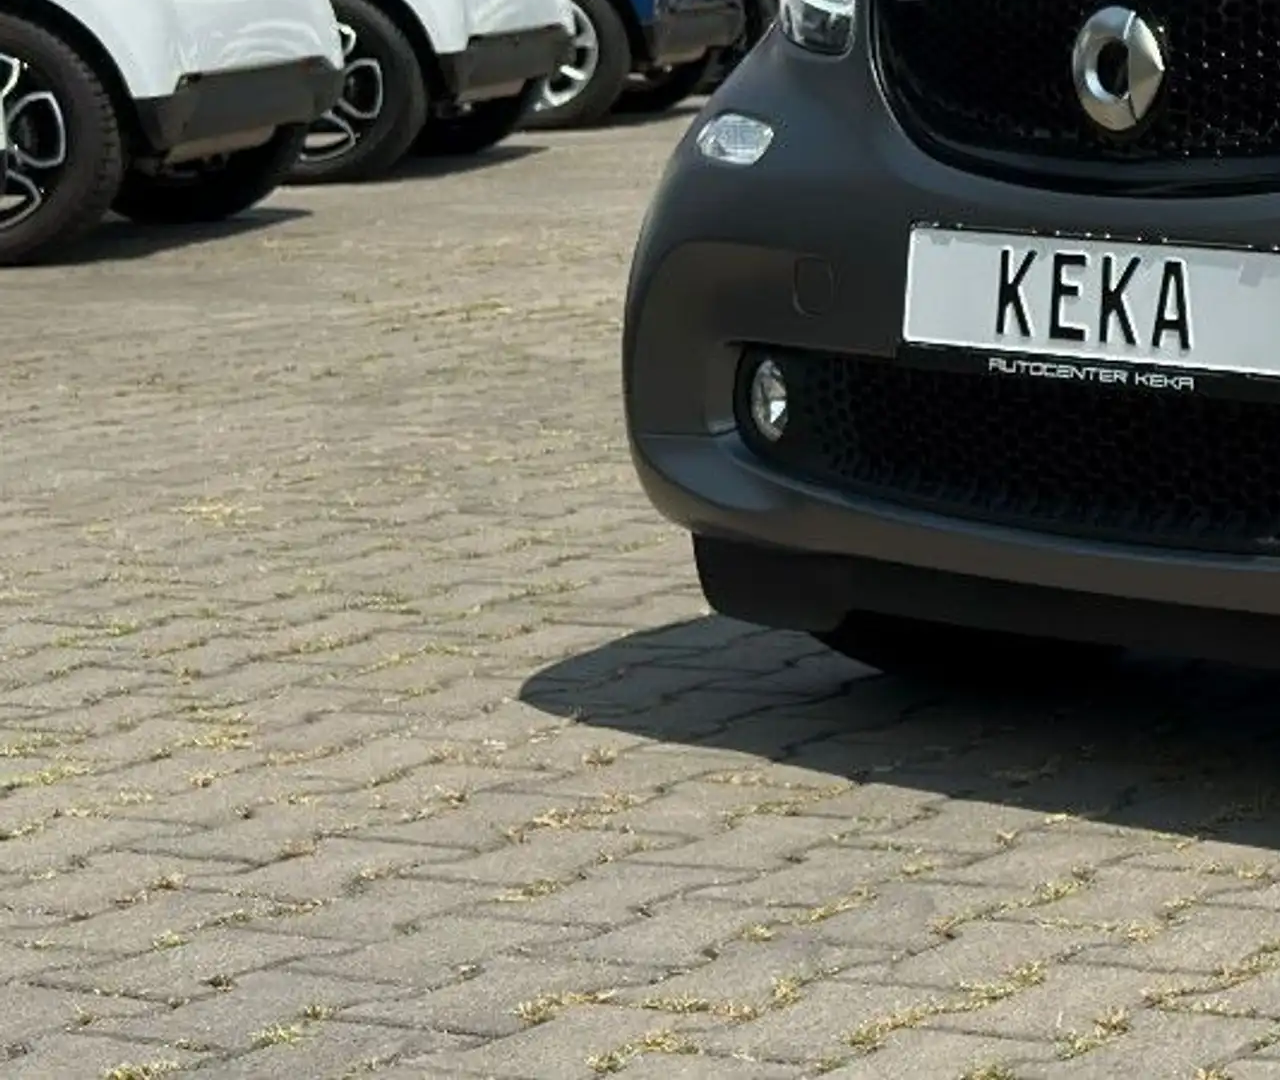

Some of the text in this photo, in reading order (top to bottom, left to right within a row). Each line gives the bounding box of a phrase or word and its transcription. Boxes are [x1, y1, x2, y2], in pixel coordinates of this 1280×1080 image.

[996, 248, 1193, 351] KEKA
[988, 358, 1195, 390] AUTOCENTER KEKA
